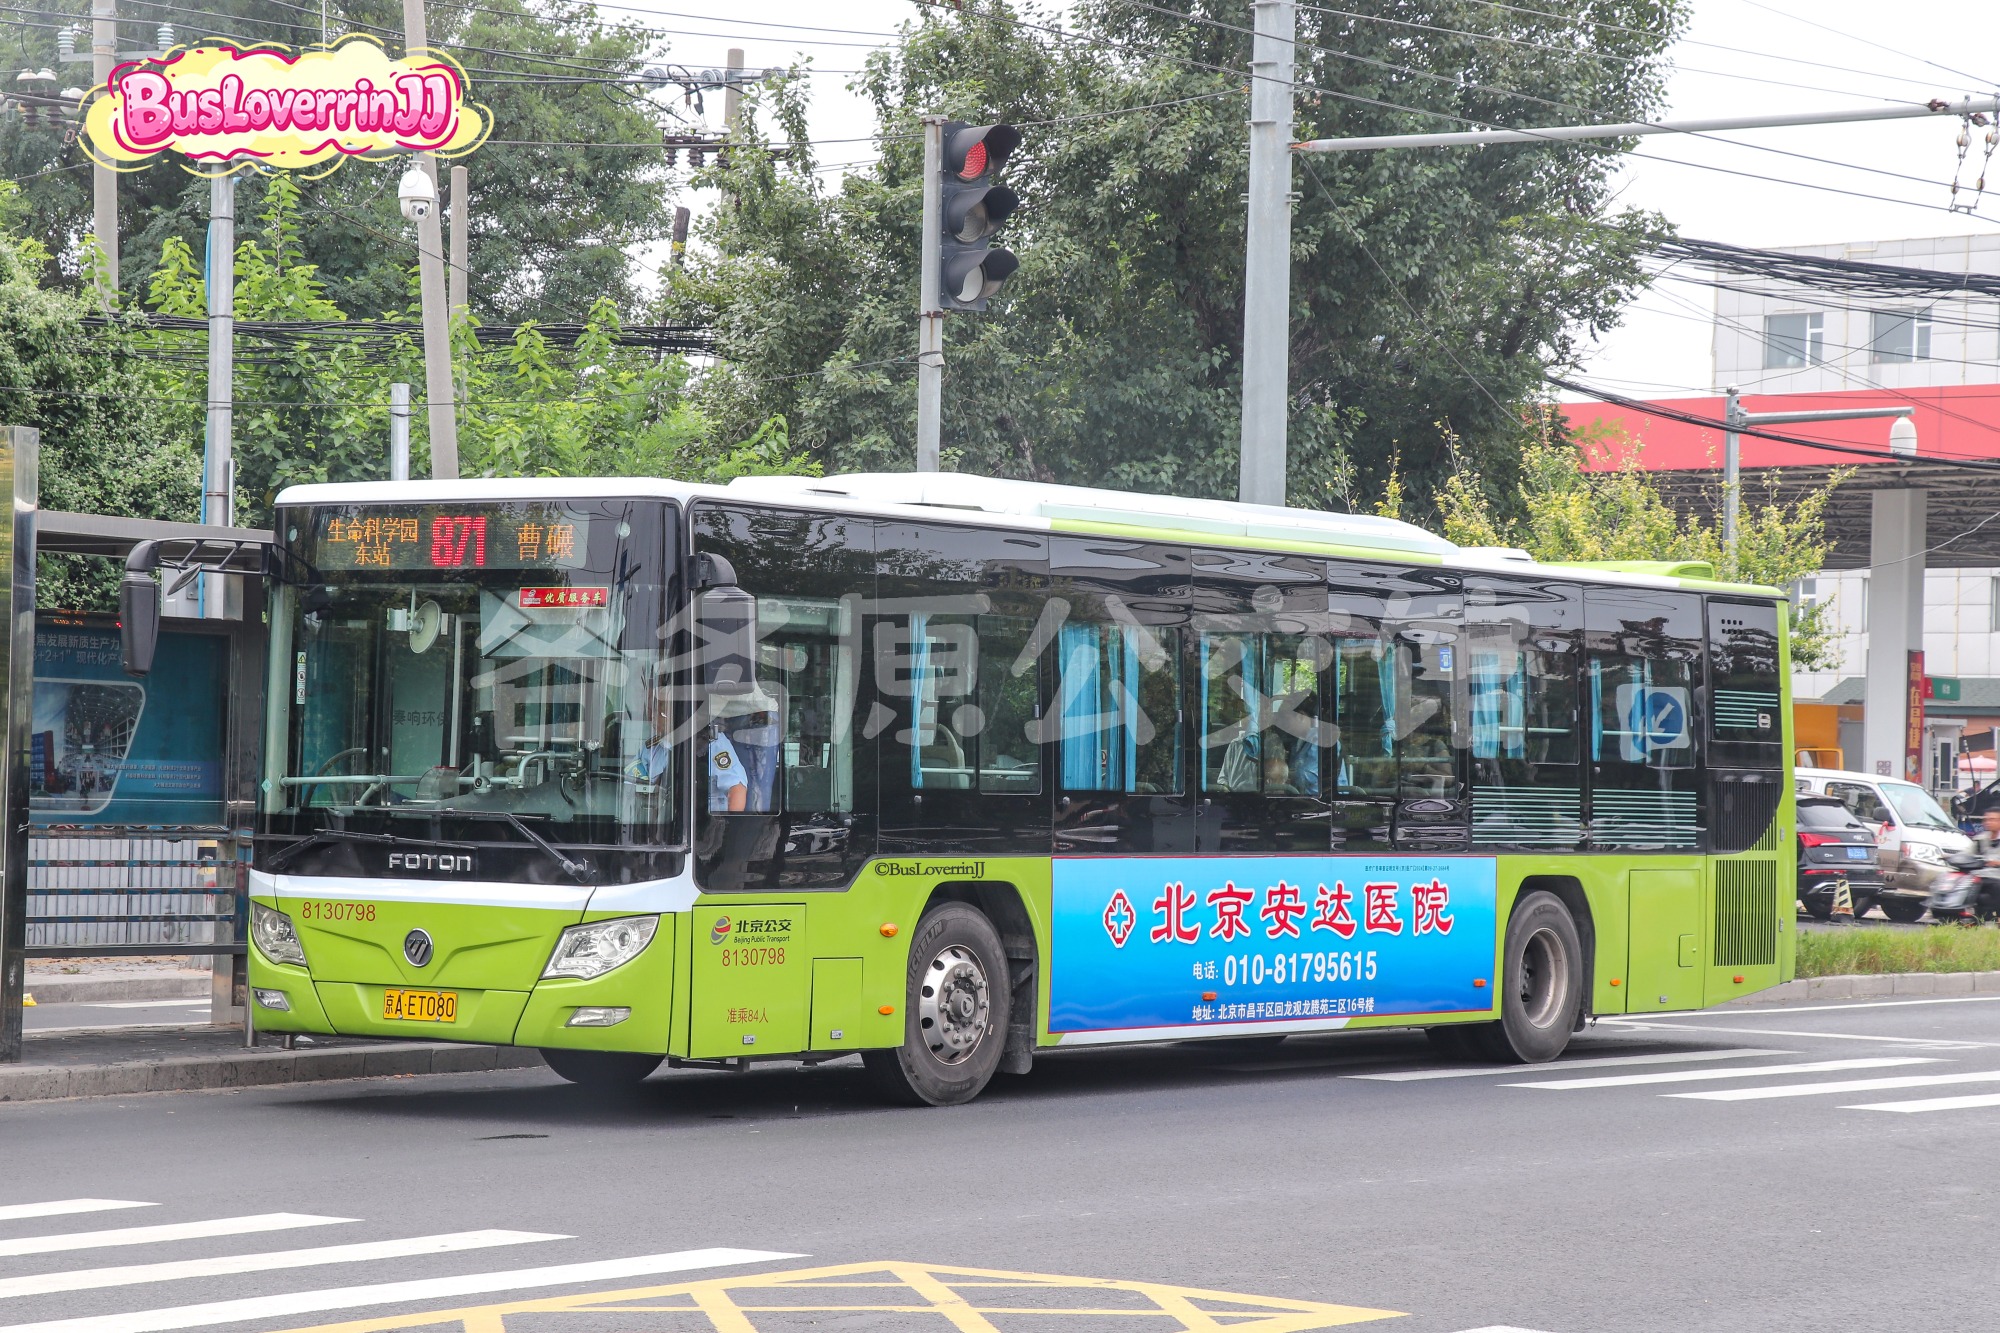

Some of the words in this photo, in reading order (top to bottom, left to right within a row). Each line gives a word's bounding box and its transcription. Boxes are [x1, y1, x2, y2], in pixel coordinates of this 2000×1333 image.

[327, 517, 419, 543] 生命科学园
[431, 516, 486, 566] 871
[516, 522, 575, 562] 曹碾
[354, 545, 391, 567] 东站
[545, 590, 602, 604] 优质服务车
[33, 633, 120, 650] 焦发展新质生产力
[388, 852, 472, 873] FOTON
[302, 901, 377, 922] 8130798
[1150, 877, 1455, 945] 北京安达医院
[735, 918, 792, 934] 北京公交
[733, 936, 751, 945] Beijing
[751, 935, 766, 944] Public
[766, 934, 791, 944] Transport
[722, 947, 786, 967] 8130798
[726, 1006, 769, 1025] 准乘84人
